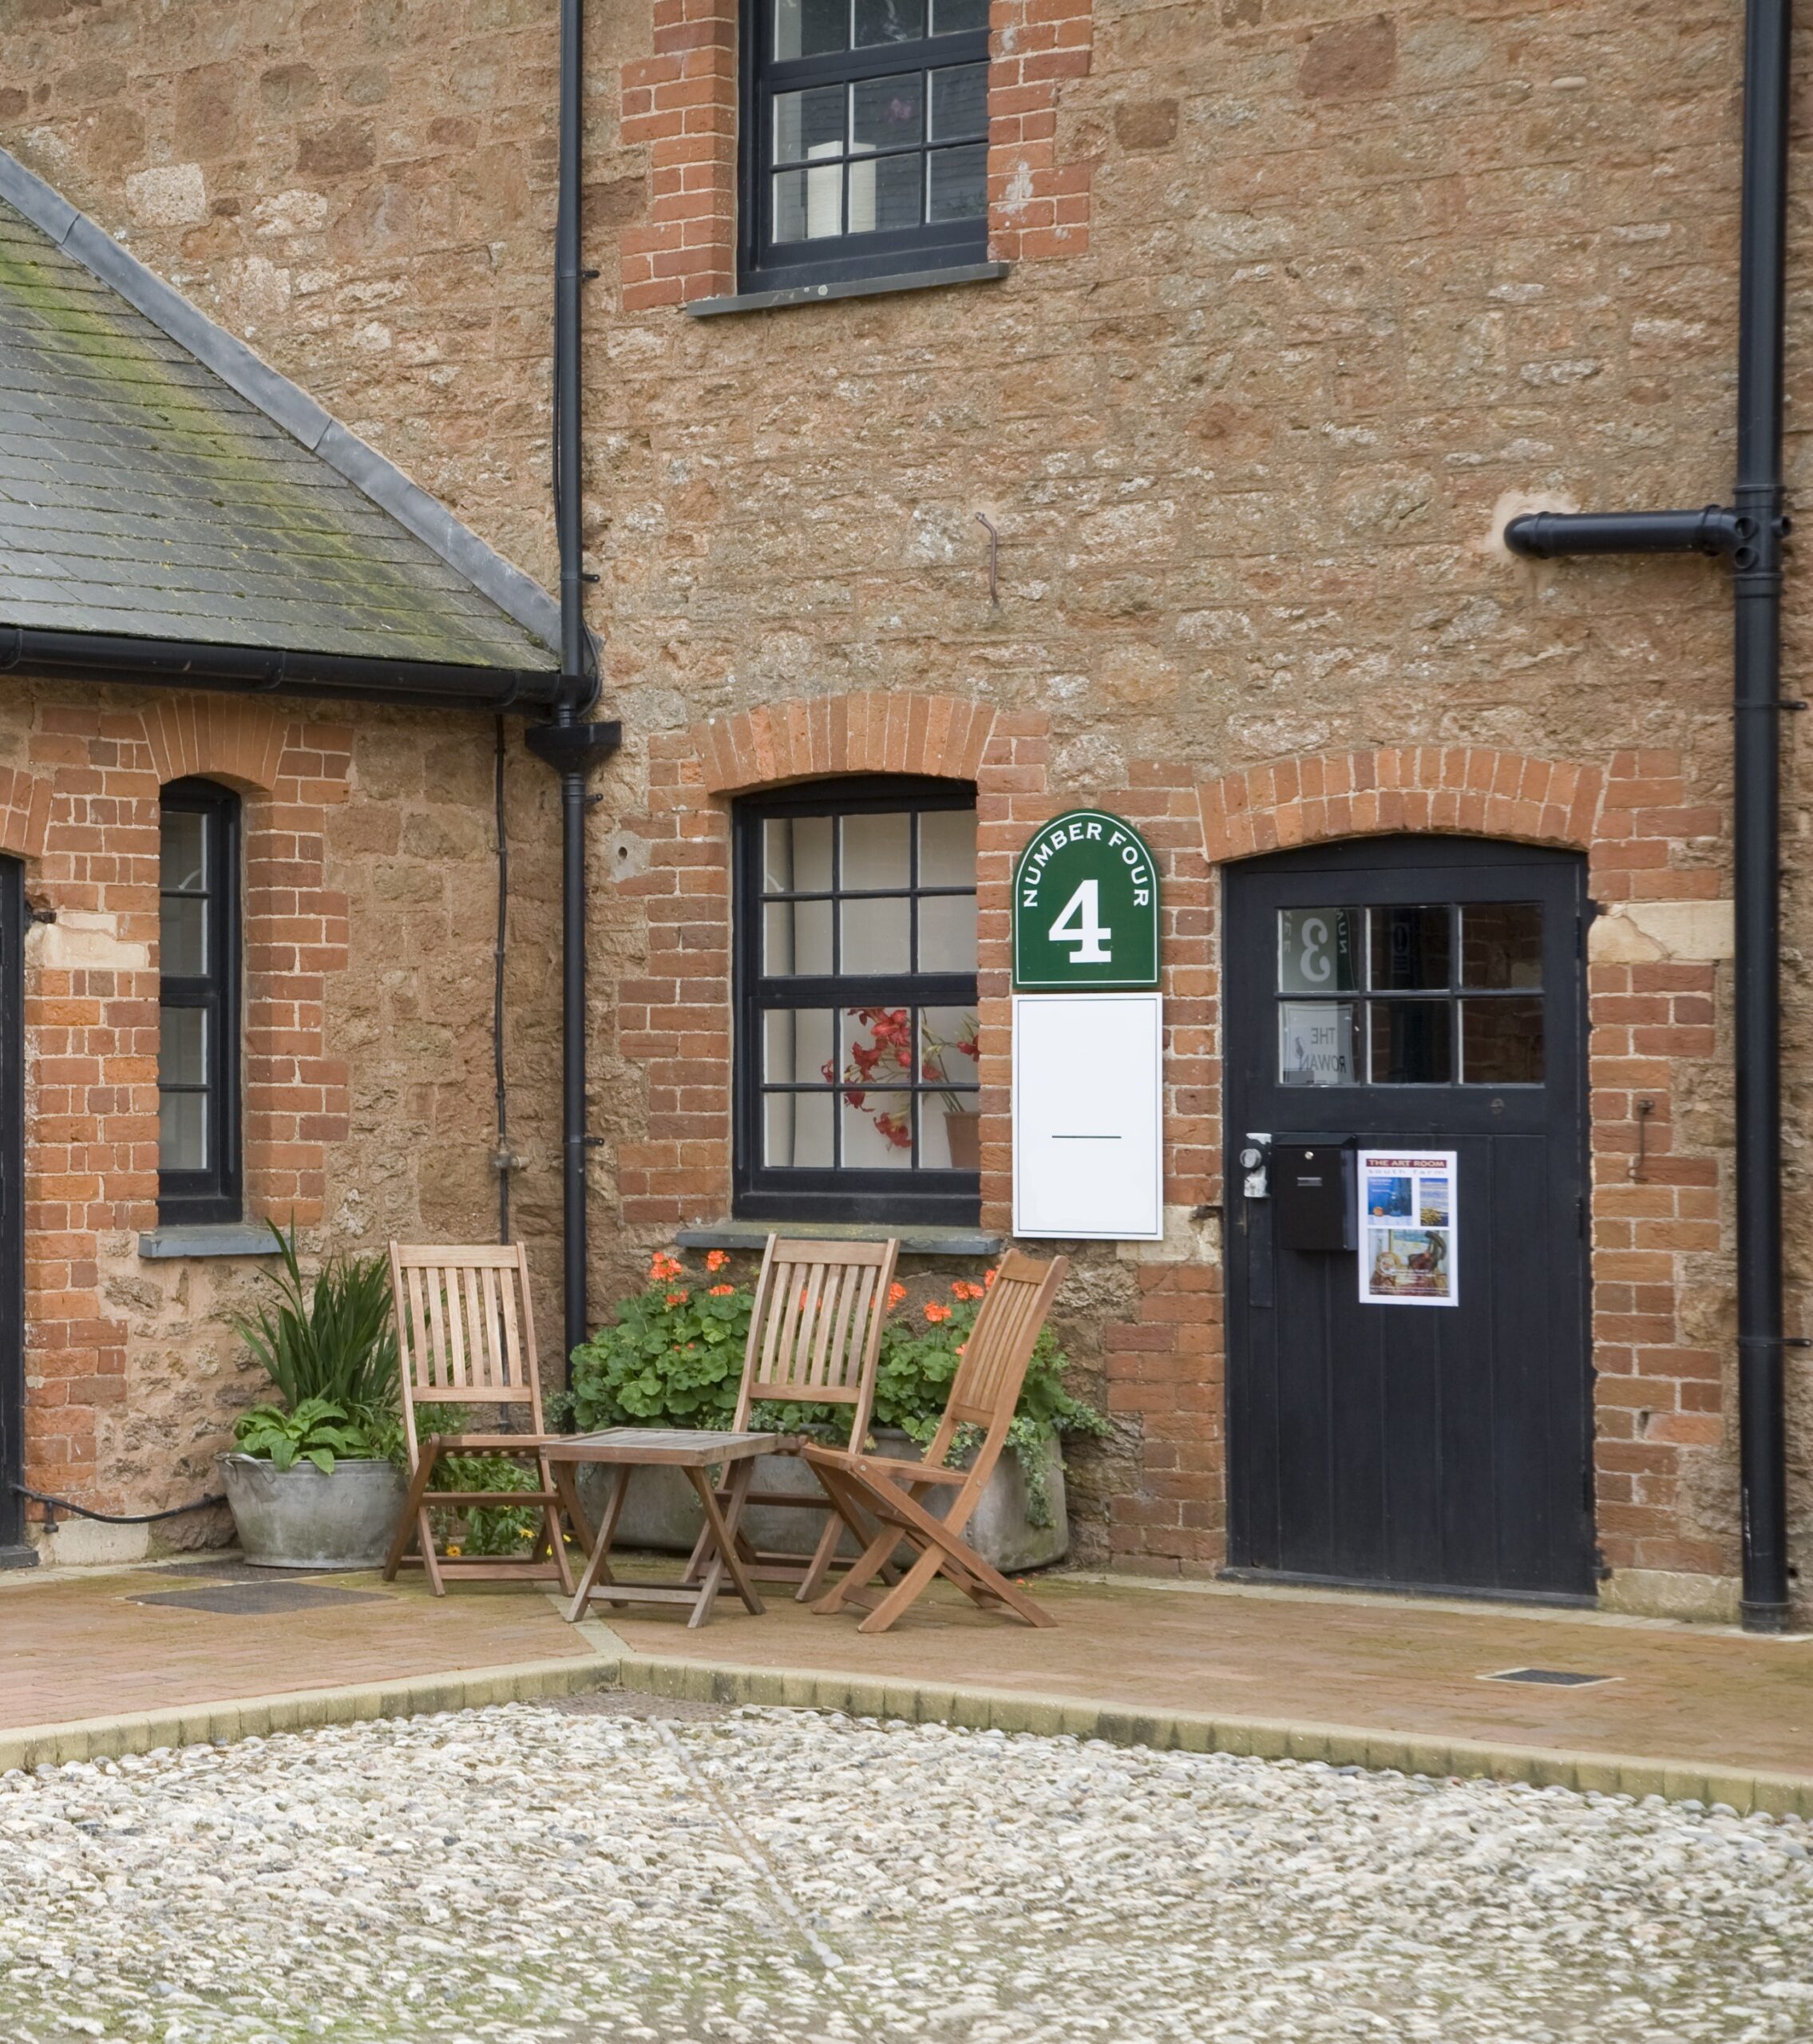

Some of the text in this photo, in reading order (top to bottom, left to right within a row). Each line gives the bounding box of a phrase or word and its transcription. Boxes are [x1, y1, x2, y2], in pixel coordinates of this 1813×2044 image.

[1023, 822, 1150, 907] NUMBER FOUR
[1048, 879, 1111, 963] 4
